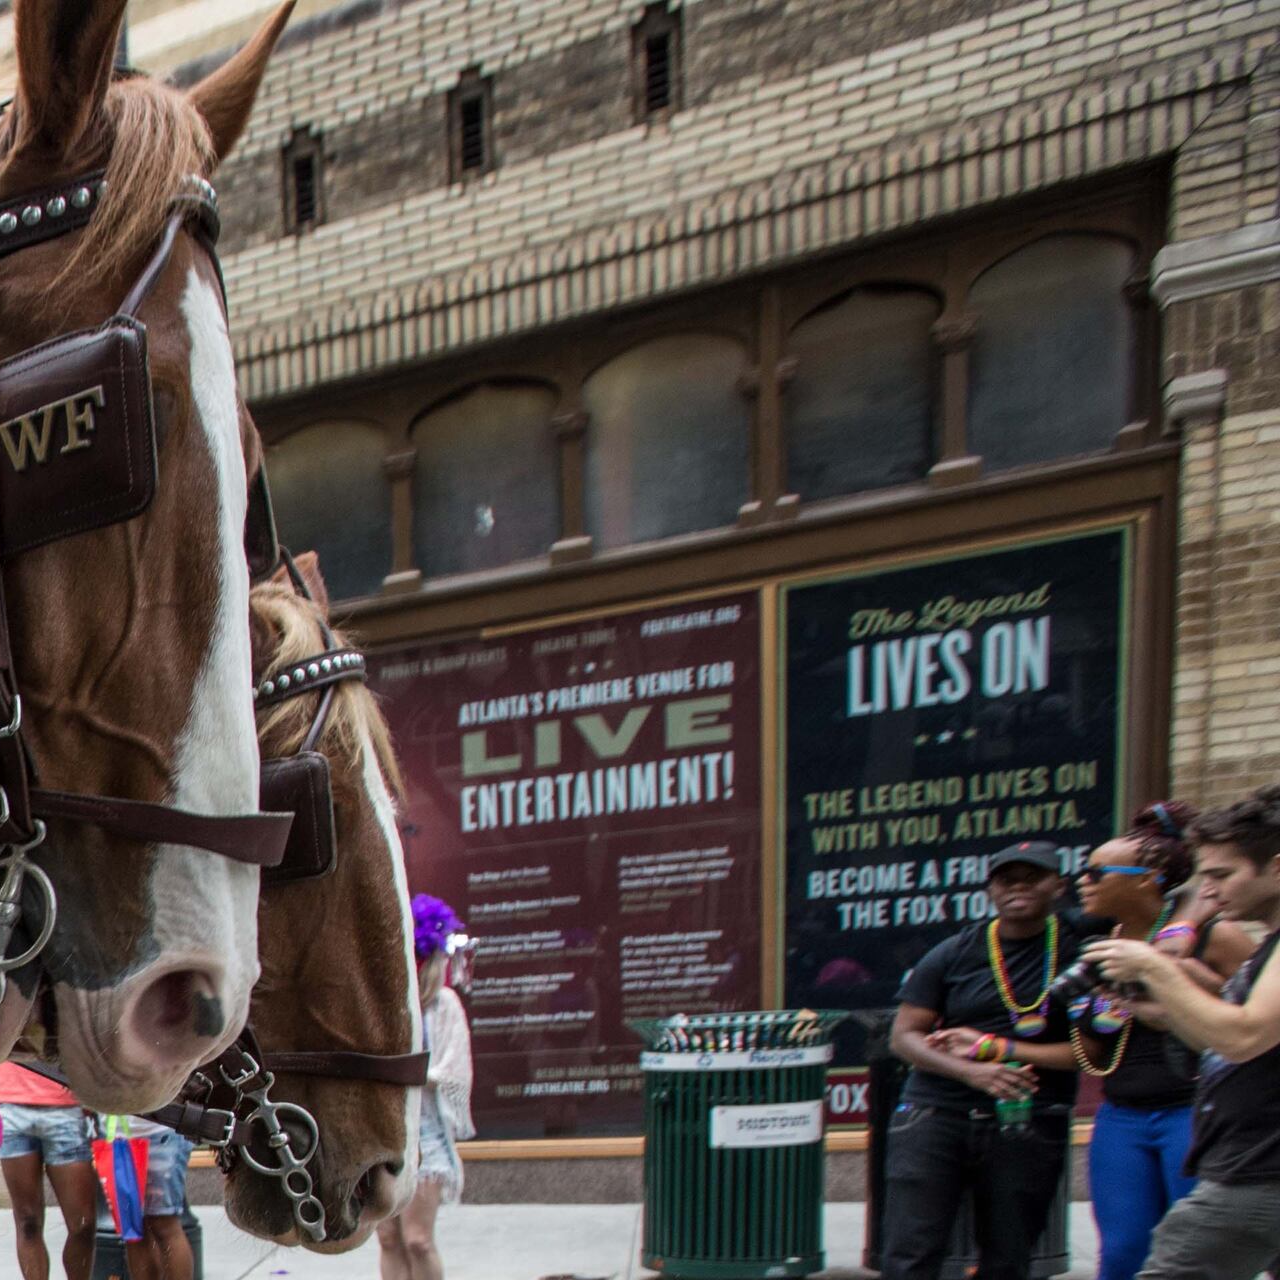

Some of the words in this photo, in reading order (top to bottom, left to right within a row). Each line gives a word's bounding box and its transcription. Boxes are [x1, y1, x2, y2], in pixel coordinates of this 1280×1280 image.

[848, 607, 914, 640] The
[915, 580, 1054, 633] Legend
[458, 693, 543, 728] ATLANTA'S
[546, 676, 634, 713] PREMIERE
[636, 665, 694, 702] VENUE
[697, 660, 736, 689] FOR
[846, 628, 973, 718] LIVES
[981, 615, 1052, 700] ON
[460, 692, 734, 779] LIVE
[460, 750, 736, 834] ENTERTAINMENT!
[803, 790, 854, 821] THE
[858, 776, 964, 816] LEGEND
[969, 764, 1049, 801] LIVES
[1054, 760, 1098, 794] ON
[811, 820, 880, 855] WITH
[884, 813, 948, 847] YOU,
[952, 799, 1087, 841] ATLANTA.
[807, 860, 918, 900] BECOME
[919, 859, 939, 890] A
[837, 899, 890, 931] THE
[894, 894, 948, 927] FOX
[826, 1082, 870, 1114] OX
